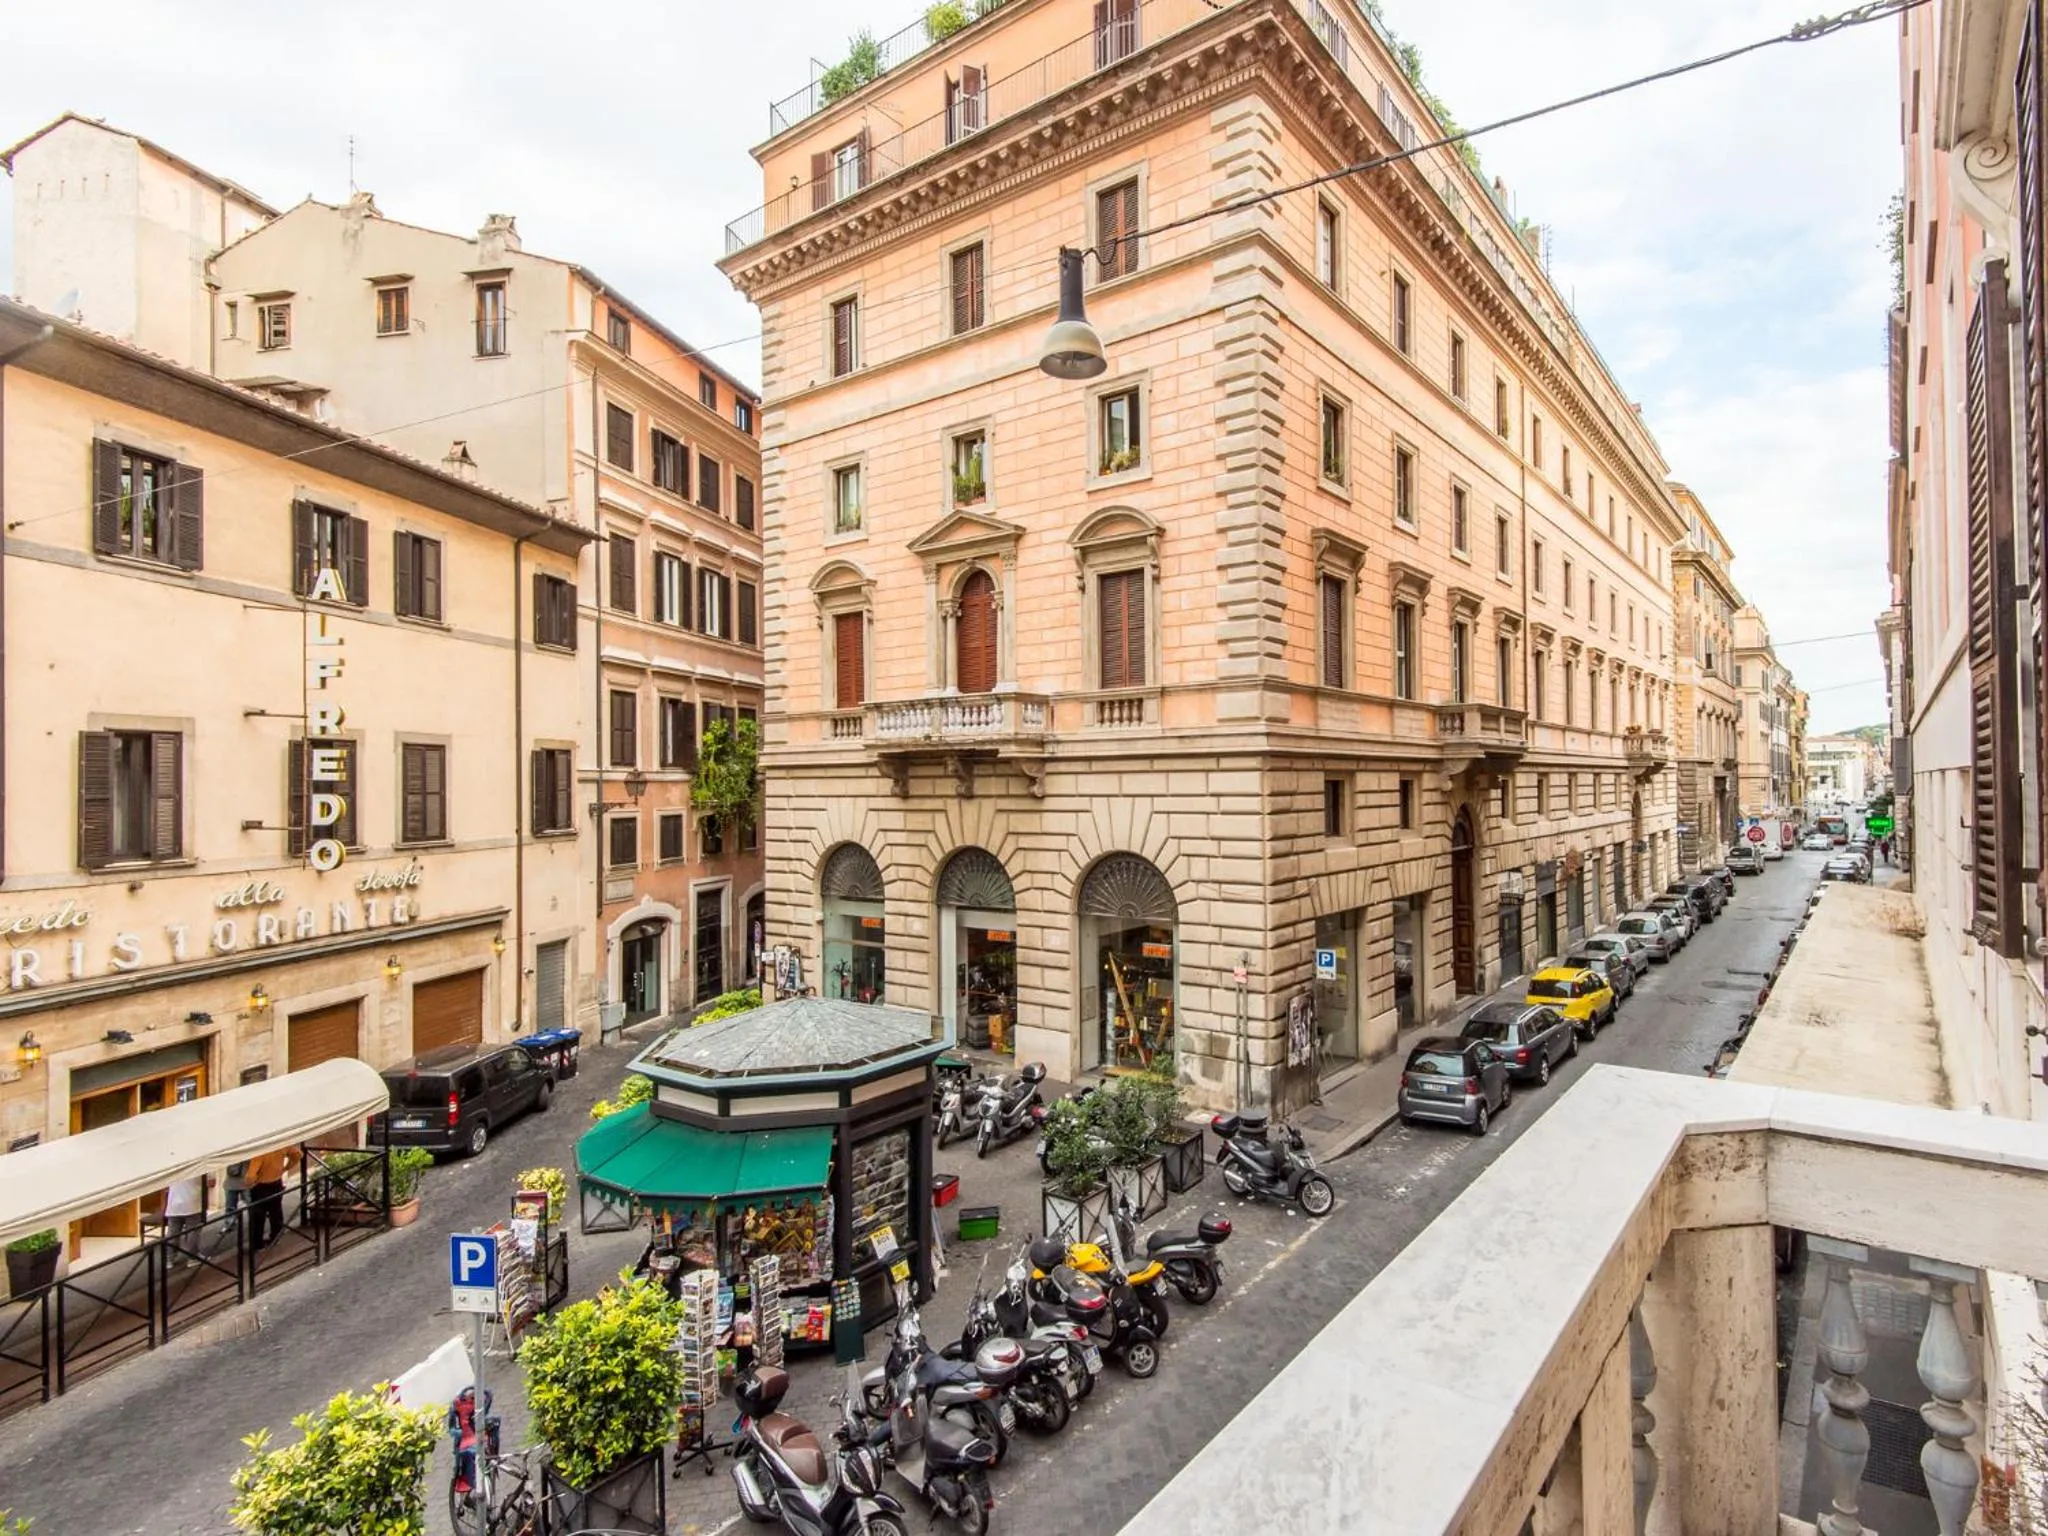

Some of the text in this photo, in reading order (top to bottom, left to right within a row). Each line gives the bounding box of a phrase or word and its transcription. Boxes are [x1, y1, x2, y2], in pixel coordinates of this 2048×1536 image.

[307, 566, 346, 871] ALFREDO
[216, 881, 285, 908] alla
[10, 895, 412, 990] RISTORANTE
[1321, 952, 1331, 966] P
[459, 1241, 487, 1282] P
